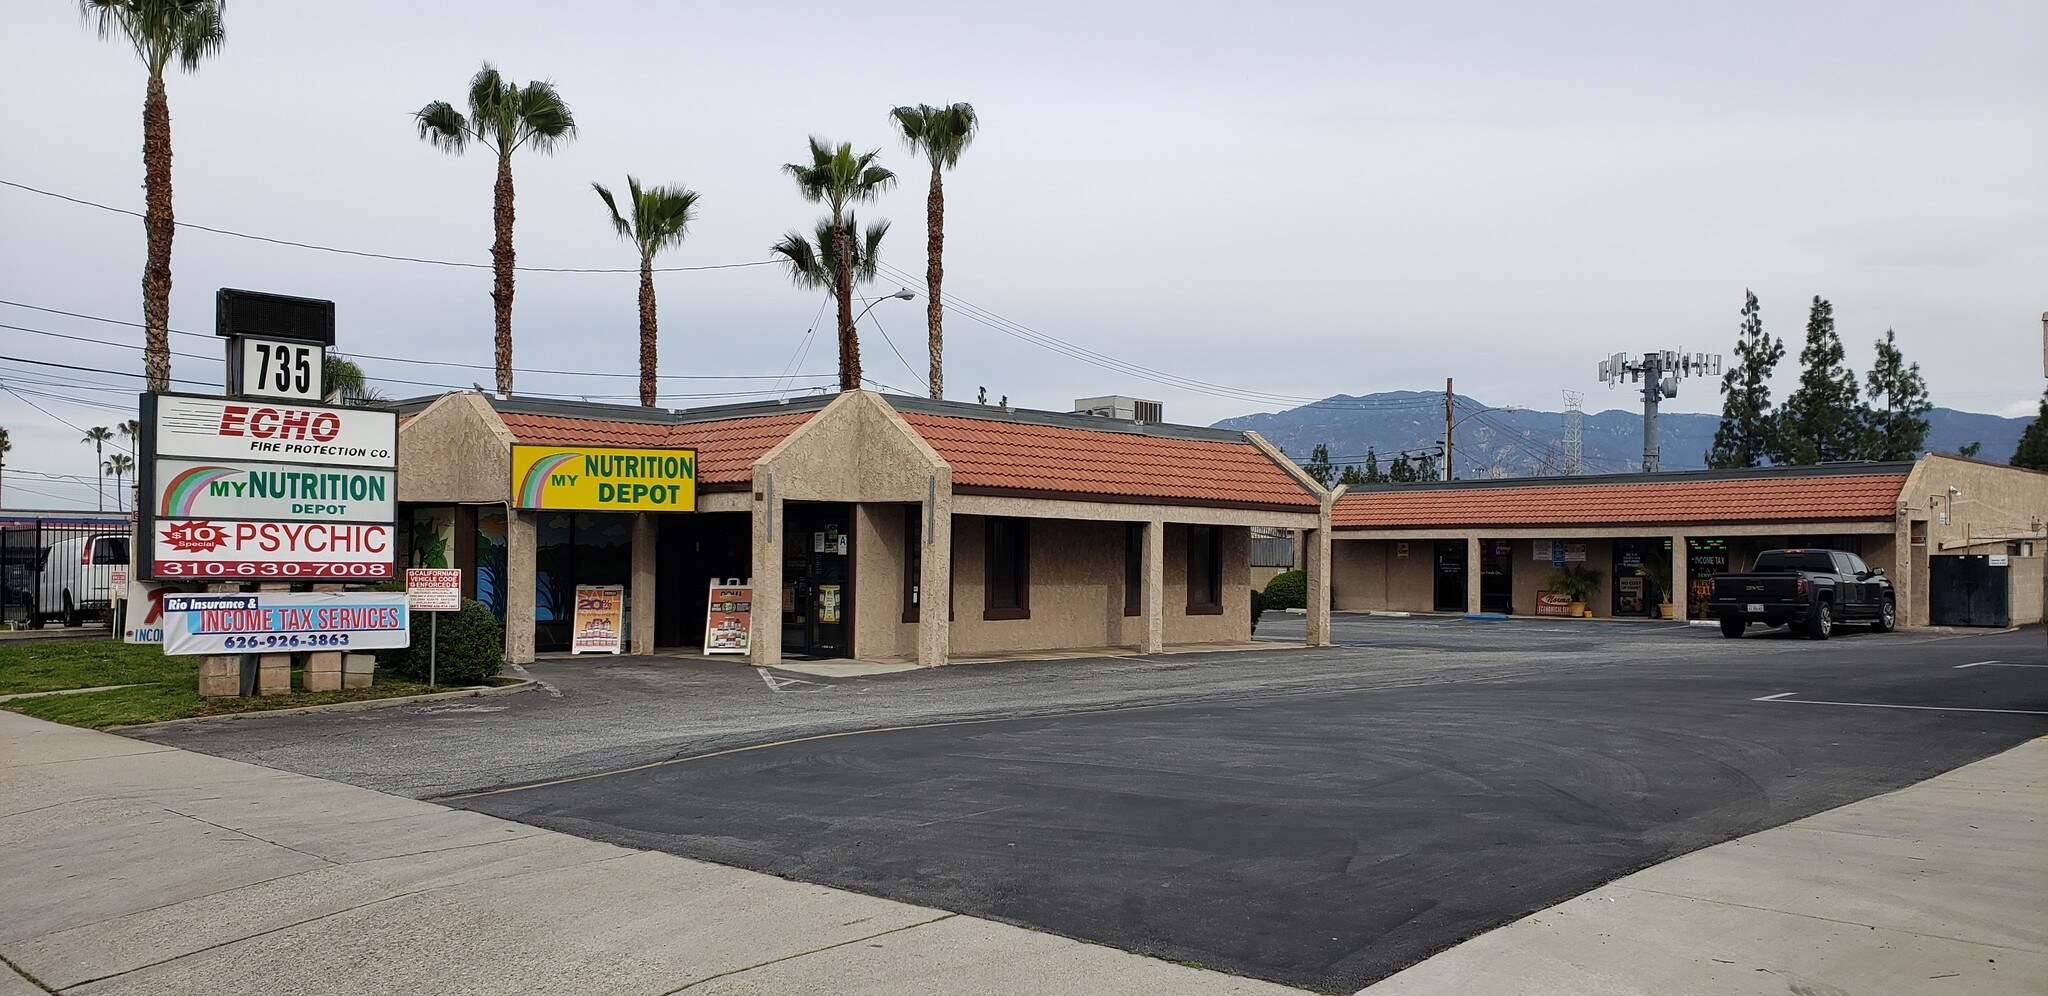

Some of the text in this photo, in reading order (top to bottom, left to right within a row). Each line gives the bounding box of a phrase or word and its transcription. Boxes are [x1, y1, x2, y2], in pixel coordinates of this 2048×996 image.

[256, 343, 311, 394] 735
[218, 405, 341, 442] ECHO
[250, 441, 391, 459] FIRE PROTECTION CO.
[585, 454, 693, 480] NUTRITION
[210, 471, 385, 502] MY NUTRITION
[551, 474, 579, 487] MY
[598, 483, 680, 505] DEPOT
[291, 503, 347, 515] DEPOT
[171, 523, 387, 553] $10 PSYCHIC
[178, 540, 215, 548] Special
[163, 562, 386, 576] 310-630-7008
[1695, 556, 1725, 565] INCOME TAX
[168, 599, 256, 610] Rio Insurance &
[200, 608, 399, 632] INCOME TAX SERVICES
[224, 634, 350, 649] 626-926-3863
